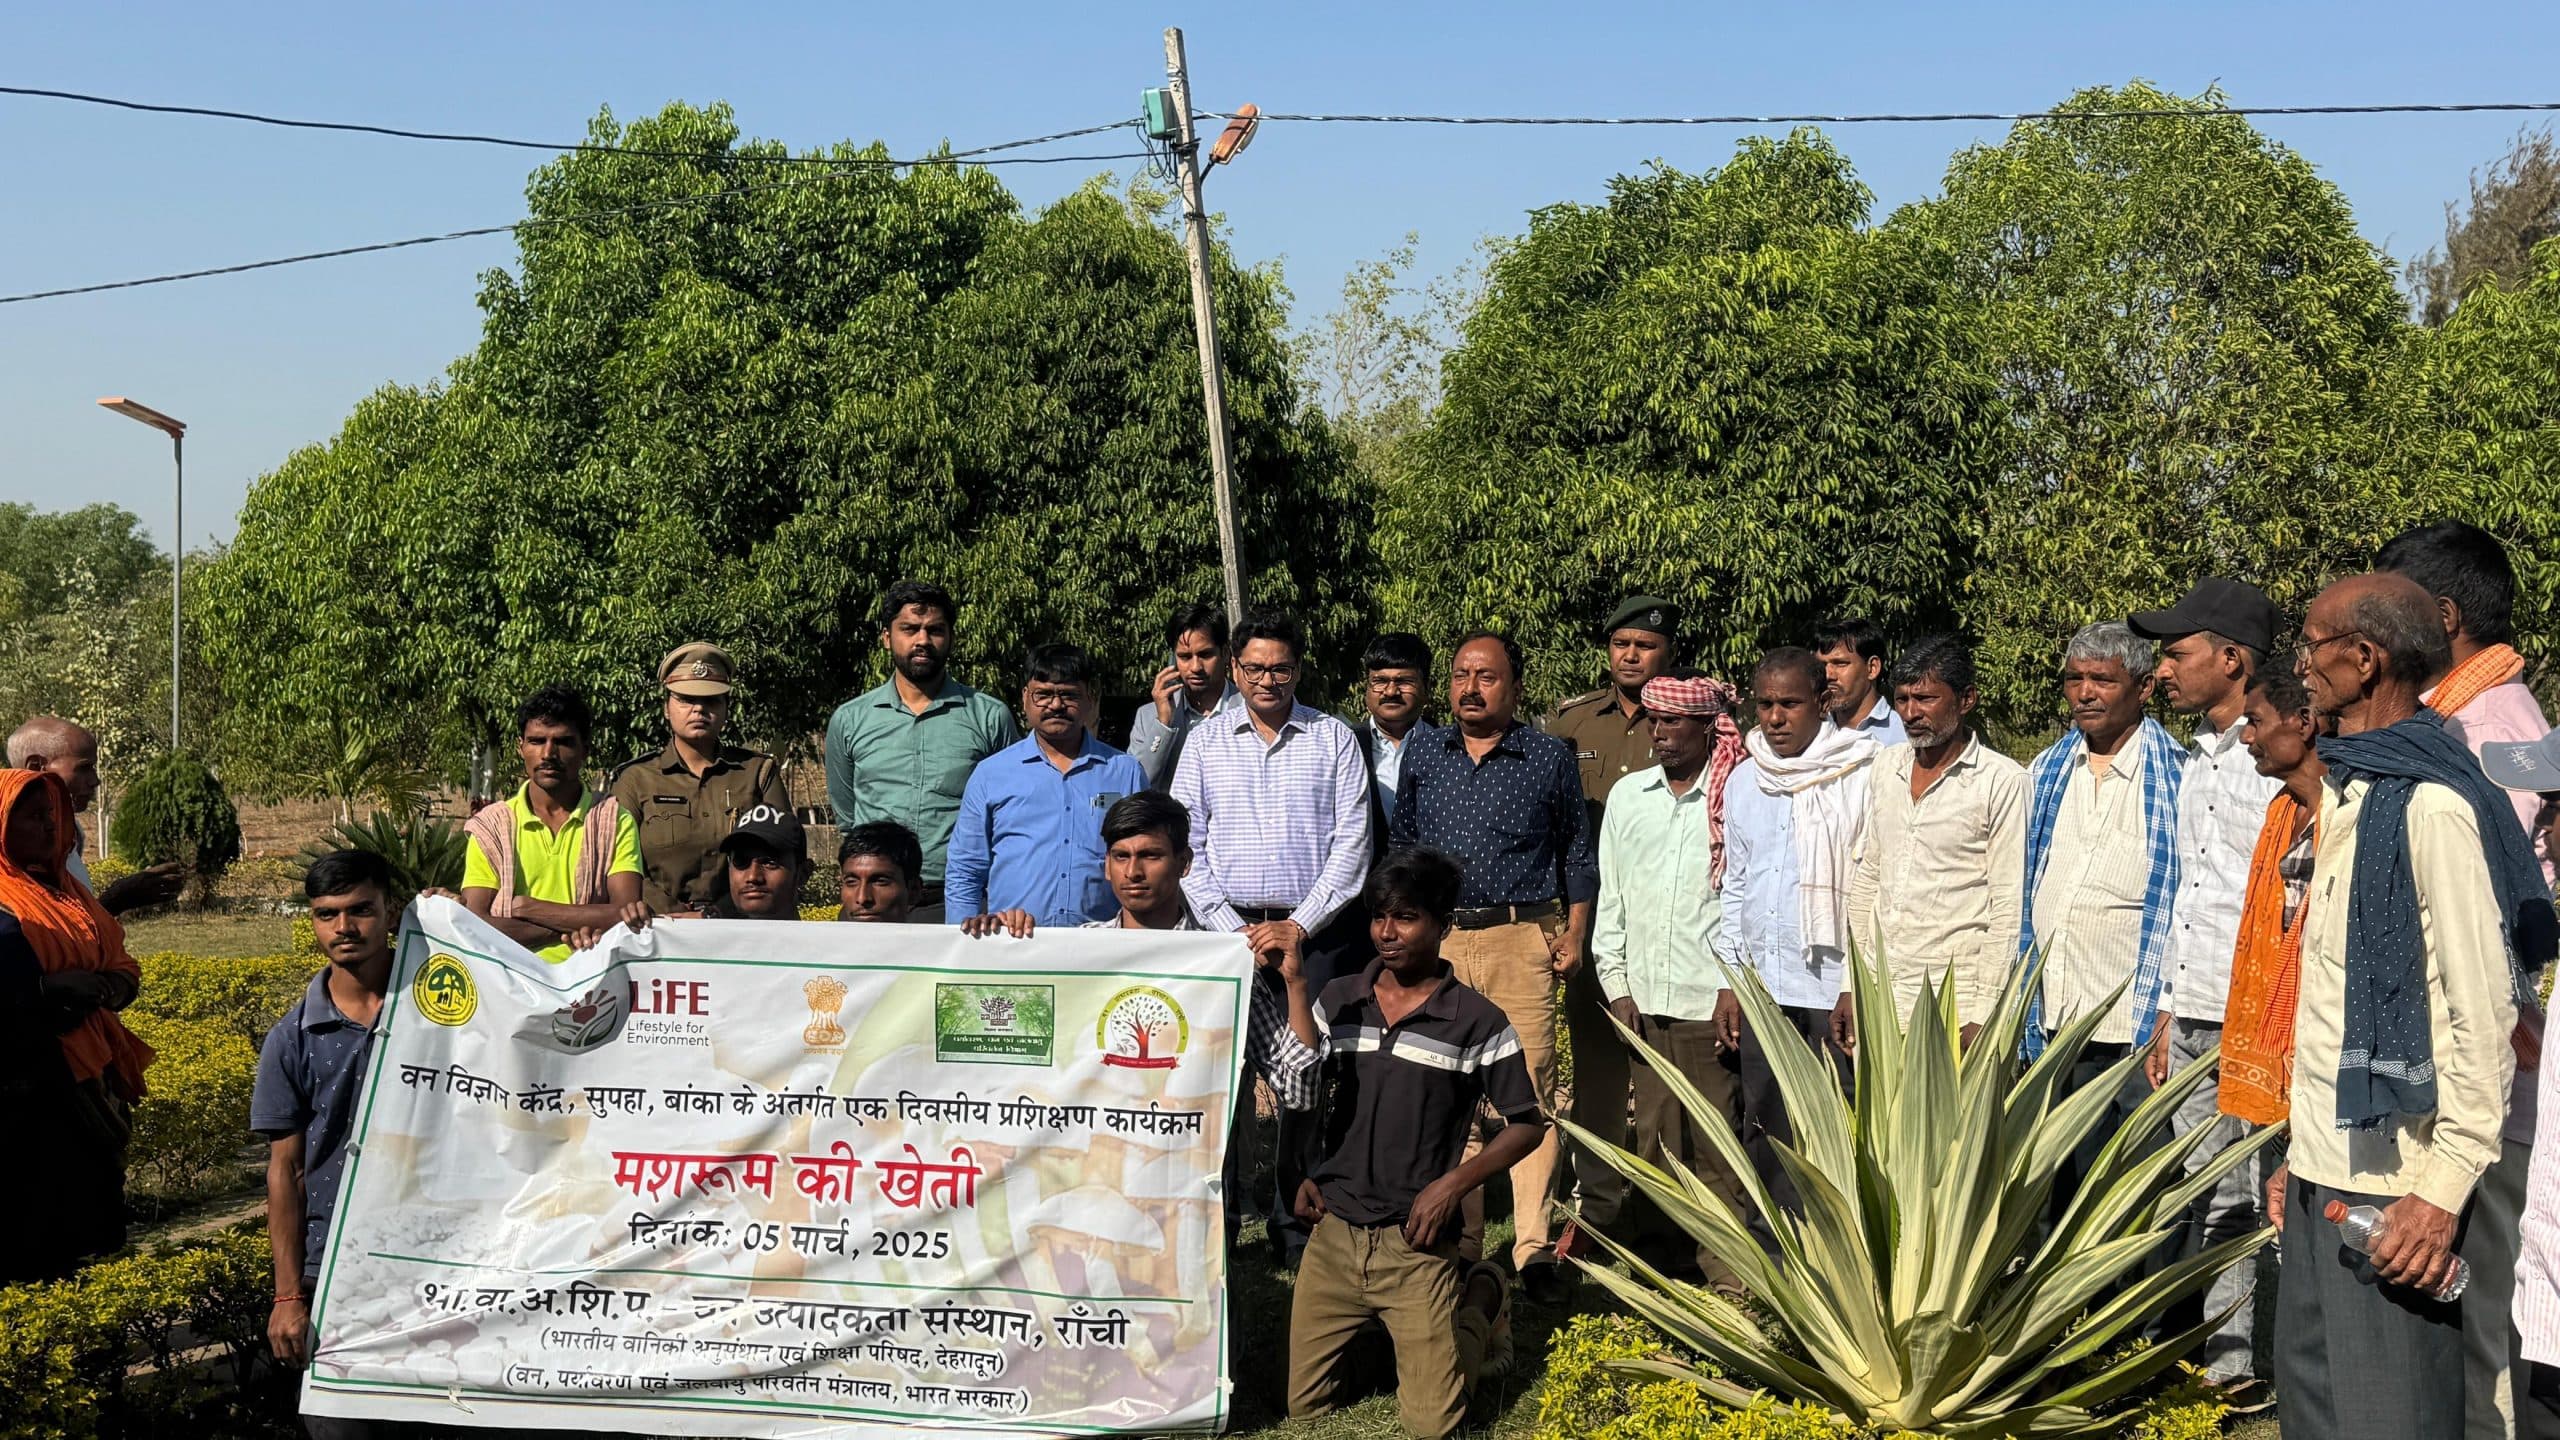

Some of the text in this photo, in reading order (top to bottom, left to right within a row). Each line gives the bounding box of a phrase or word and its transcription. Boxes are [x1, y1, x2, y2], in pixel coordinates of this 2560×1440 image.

[738, 804, 785, 828] BOY
[628, 978, 709, 1016] LiFE
[627, 1020, 704, 1034] Lifestyle for
[627, 1032, 709, 1046] Environment
[400, 1064, 440, 1092] वन
[446, 1064, 510, 1111] विज्ञान
[663, 1082, 724, 1115] बांका
[730, 1084, 757, 1115] के
[763, 1085, 837, 1118] अंतर्गत
[842, 1097, 889, 1127] एक
[895, 1090, 992, 1125] दिवसीय
[998, 1095, 1097, 1133] प्रशिक्षण
[1103, 1101, 1204, 1136] कार्यक्रम
[612, 1140, 983, 1209] मशरूम की खेती
[744, 1223, 780, 1251] 05
[790, 1218, 860, 1260] मार्च,
[872, 1231, 949, 1259] 2025
[752, 1299, 912, 1337] उत्पादकता
[920, 1299, 1043, 1347] संस्थान,
[541, 1327, 618, 1351] (भारतीय
[623, 1331, 688, 1355] वानिकी
[778, 1342, 807, 1367] एवं
[811, 1342, 862, 1362] शिक्षा
[867, 1340, 929, 1368] परिषद,
[935, 1344, 1004, 1377] देहरादून)
[639, 1372, 669, 1393] एवं
[673, 1378, 746, 1395] जलवायु
[752, 1371, 822, 1394] परिवर्तन
[827, 1374, 898, 1404] मंत्रालय,
[905, 1385, 950, 1405] भारत
